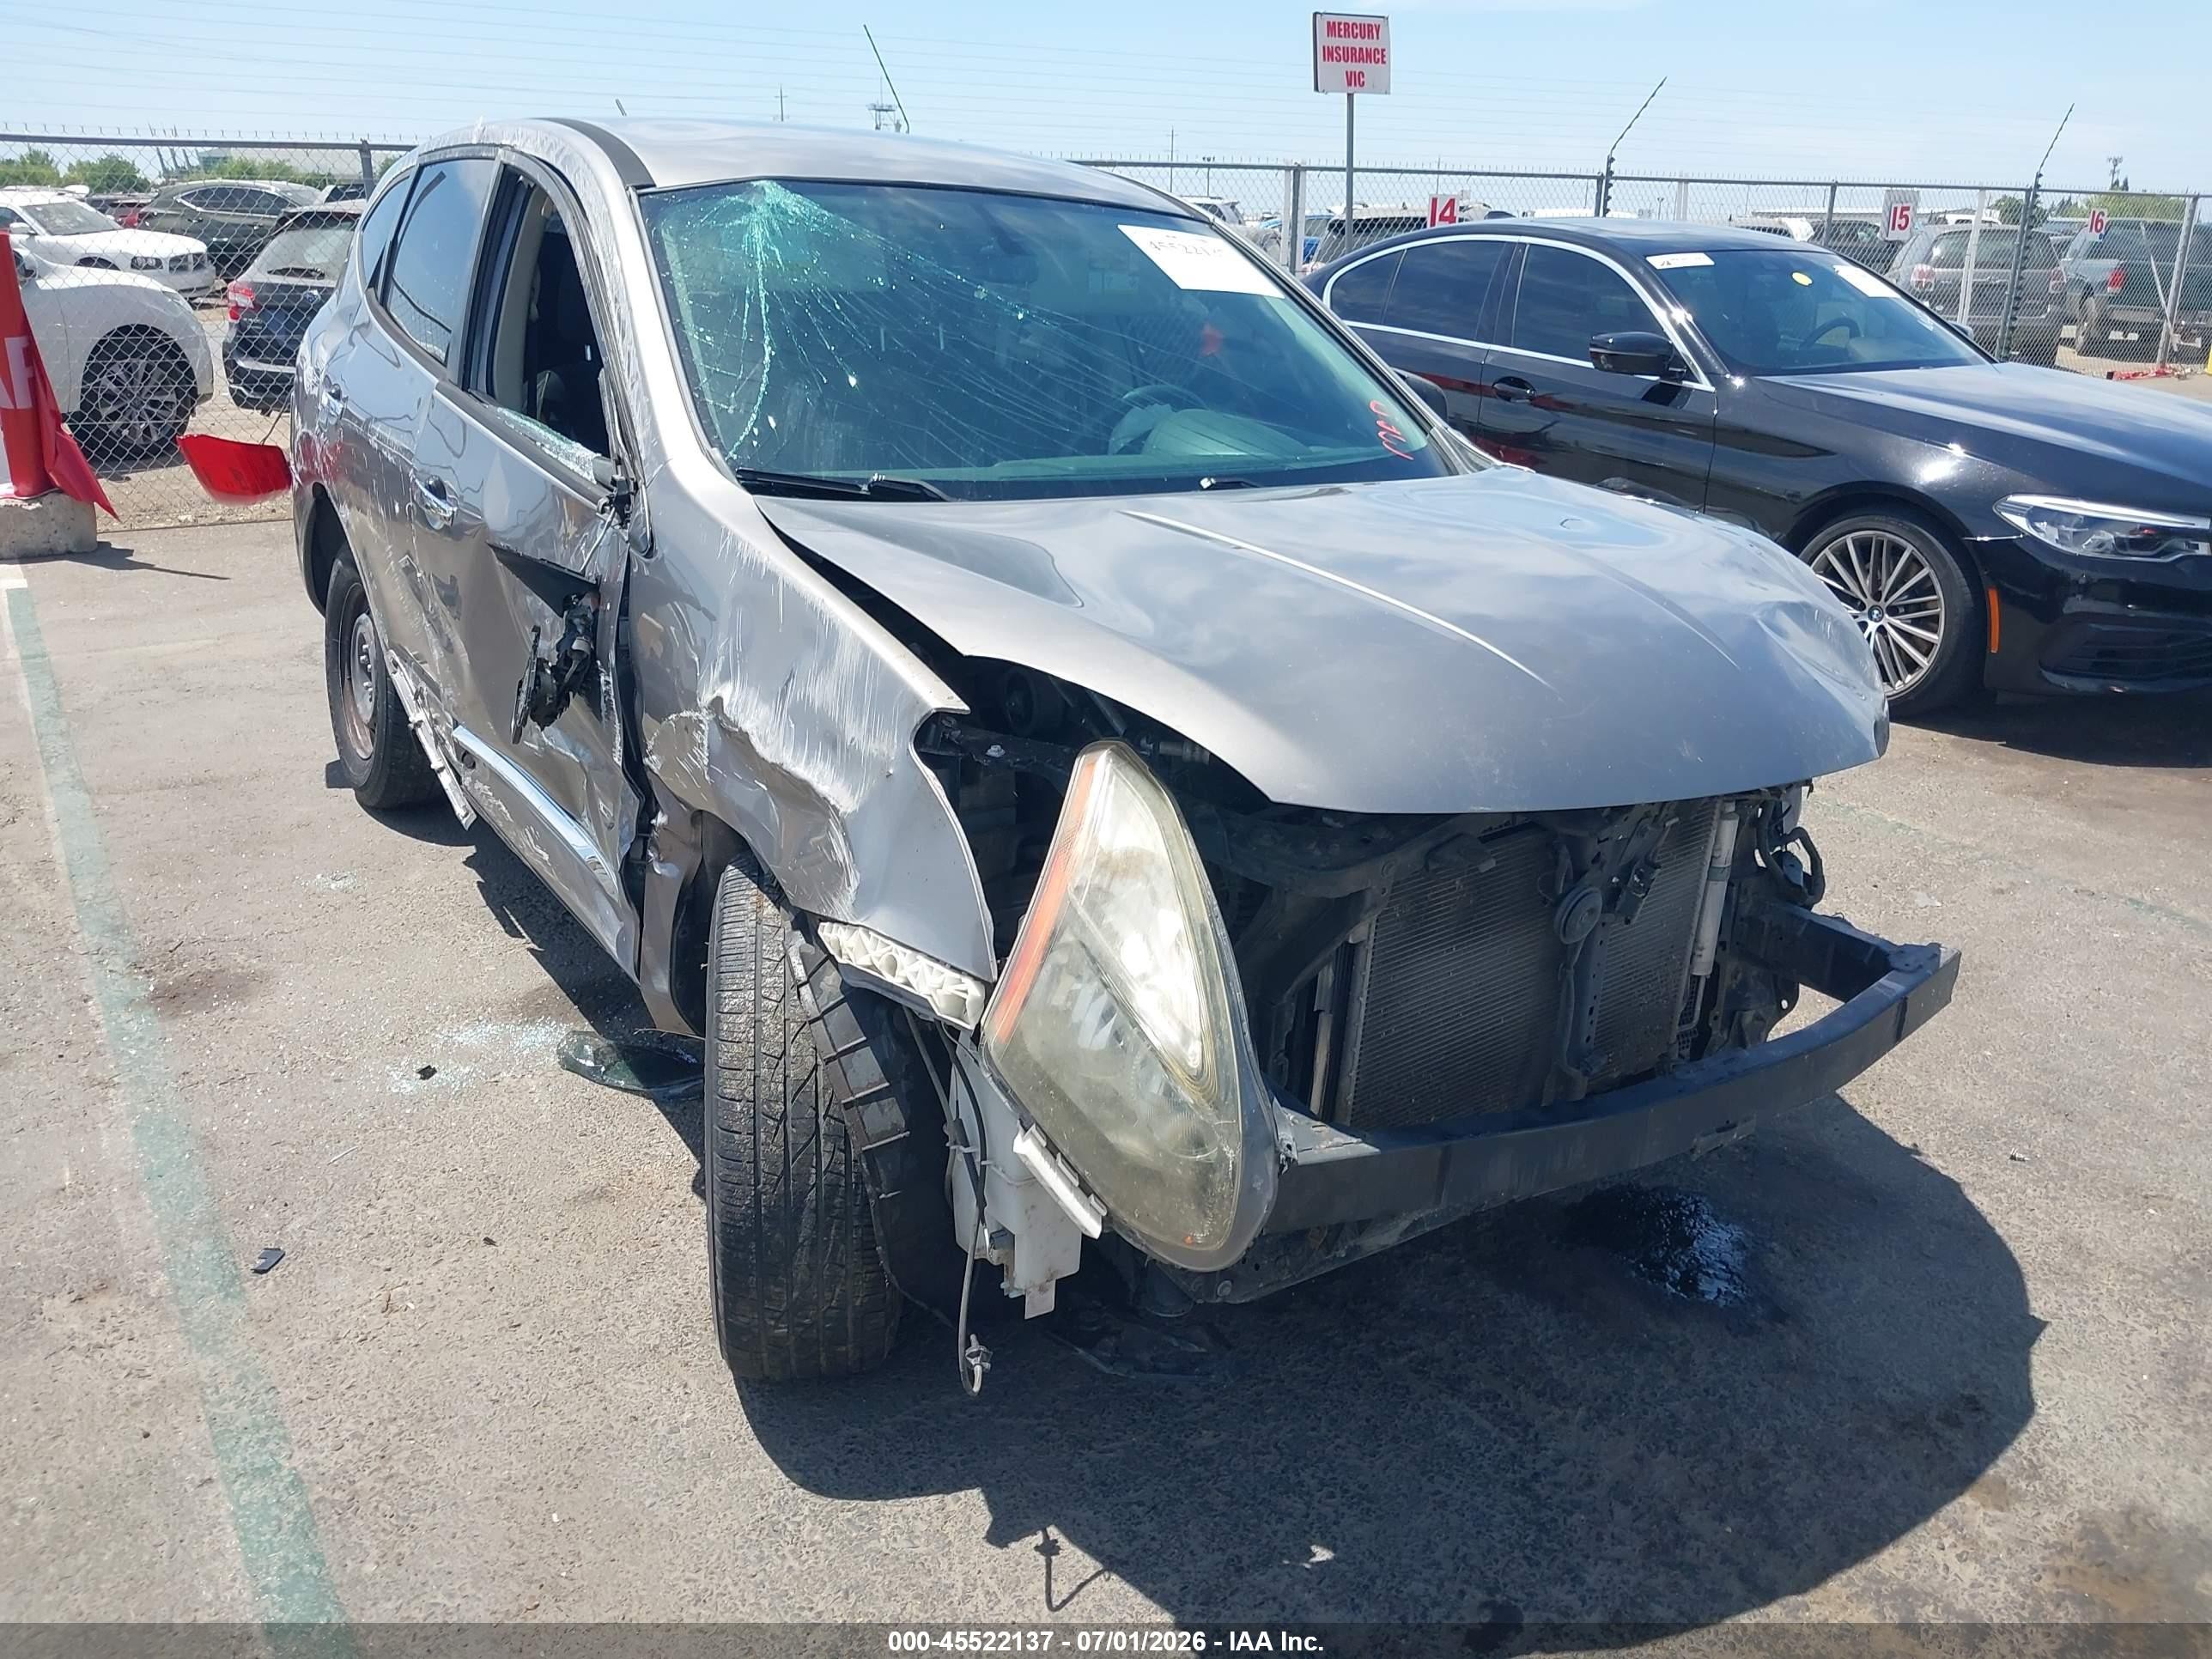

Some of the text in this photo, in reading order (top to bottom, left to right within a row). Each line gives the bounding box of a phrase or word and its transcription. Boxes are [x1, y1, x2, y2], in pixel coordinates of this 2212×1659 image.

[1326, 21, 1381, 40] MERCURY
[1322, 46, 1386, 64] INSURANCE
[1346, 70, 1365, 88] VIC
[1430, 197, 1457, 228] 14
[1891, 206, 1911, 231] 15
[2089, 210, 2105, 233] 16
